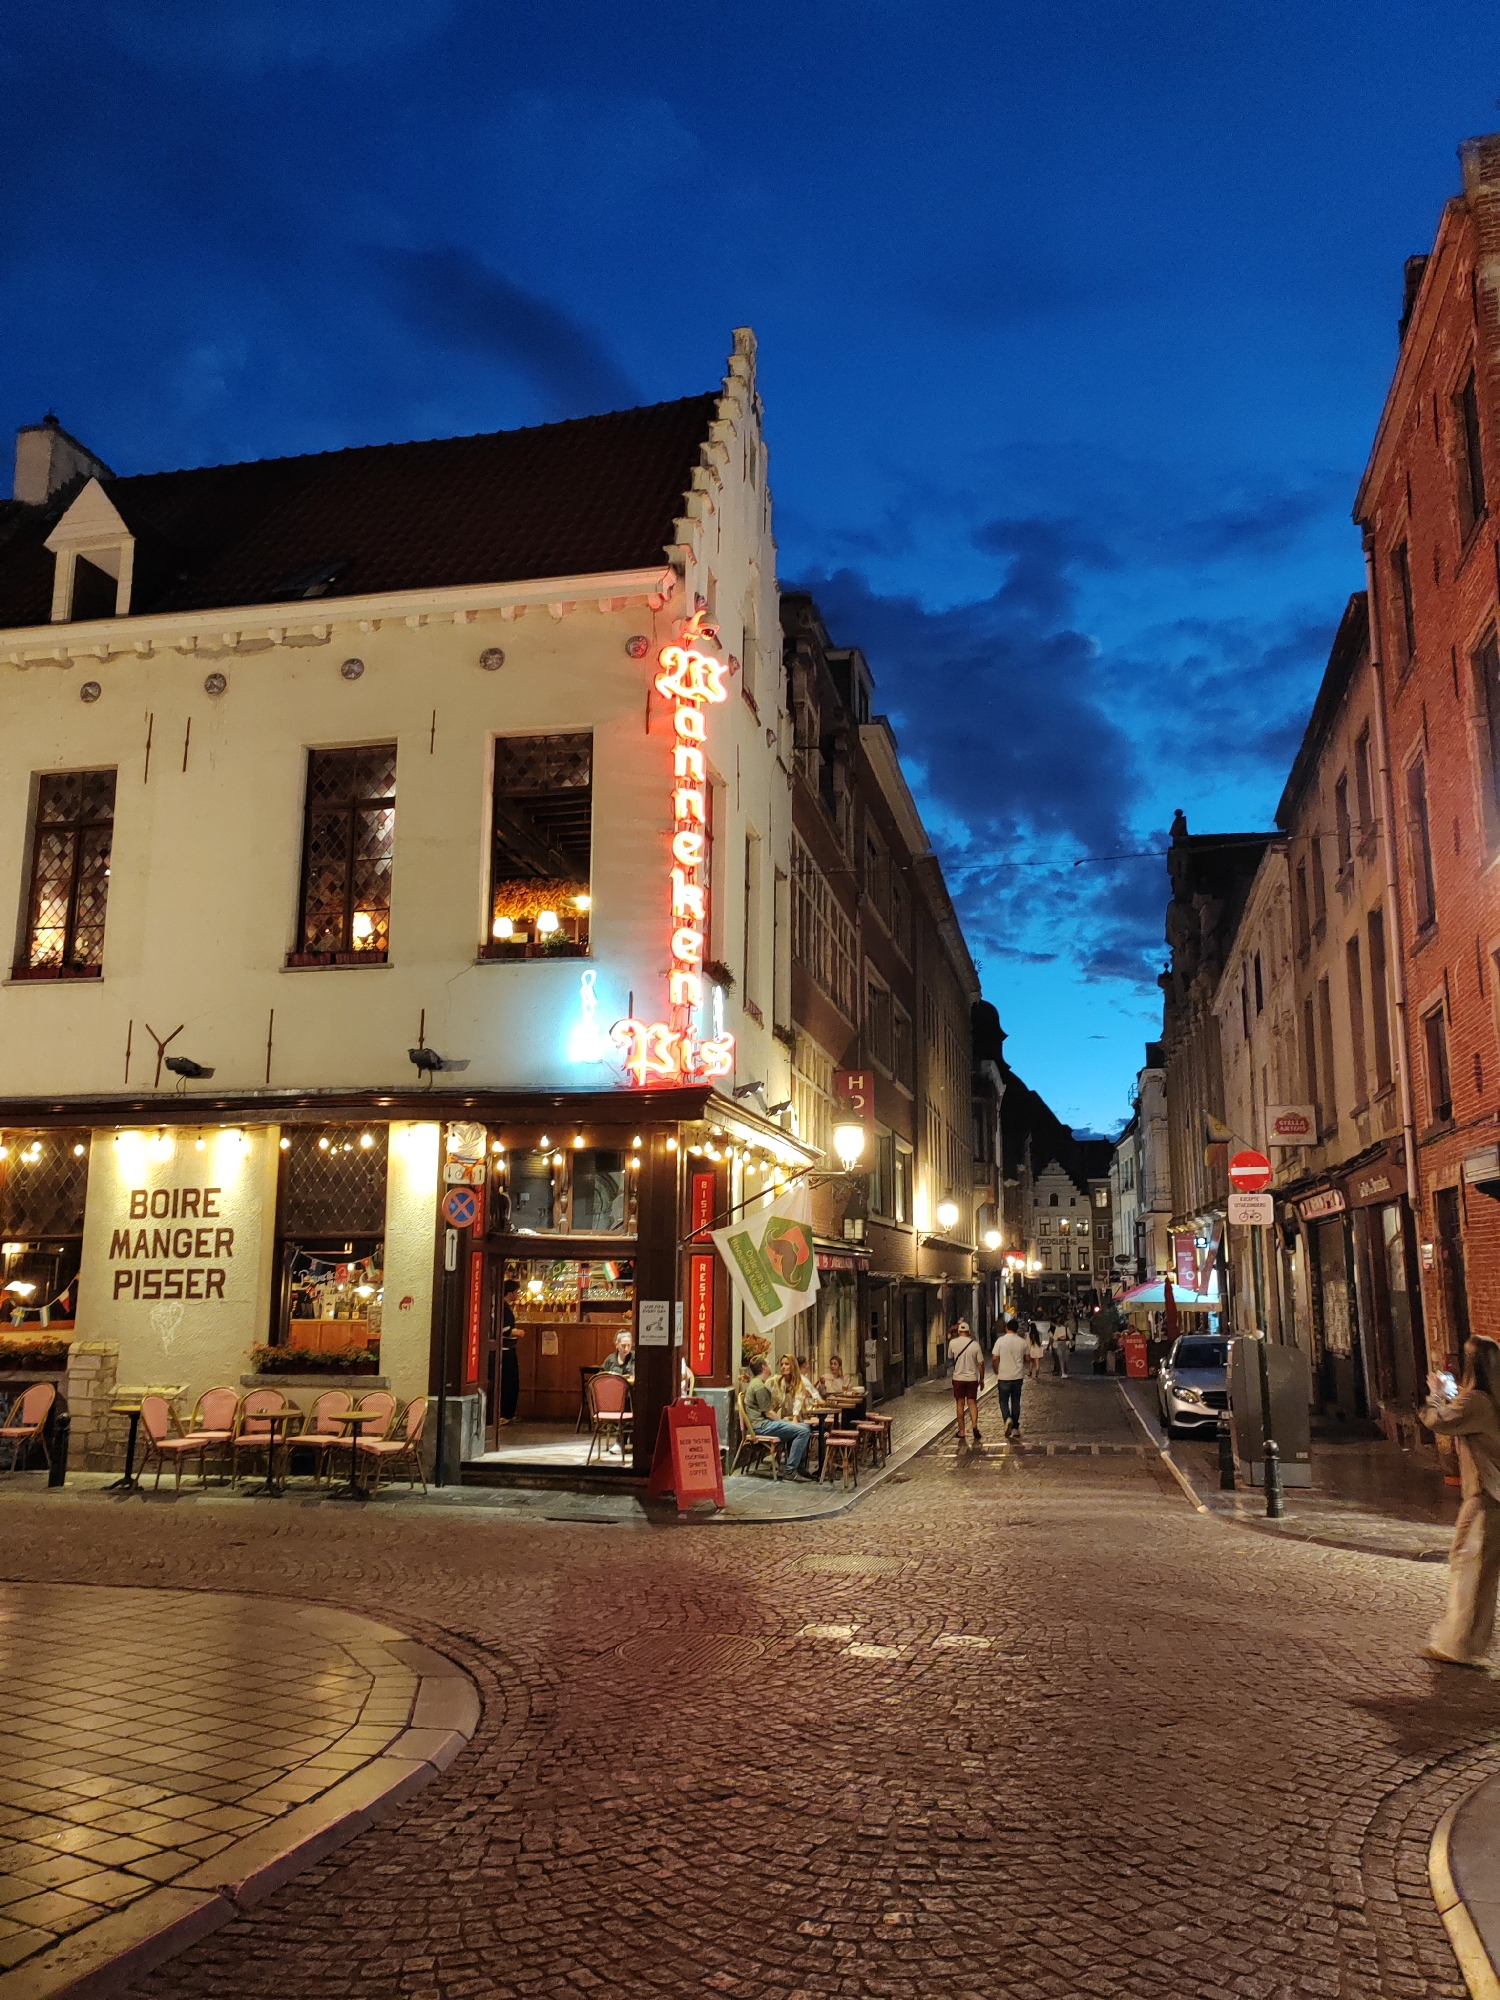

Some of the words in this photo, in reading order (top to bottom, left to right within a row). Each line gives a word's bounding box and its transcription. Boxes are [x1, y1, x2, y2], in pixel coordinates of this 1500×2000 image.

[655, 647, 727, 1006] Manneken
[610, 1018, 734, 1086] Pis
[130, 1187, 221, 1219] BOIRE
[109, 1227, 235, 1260] MANGER
[113, 1268, 226, 1300] PISSER
[698, 1263, 707, 1362] RESTAURANT
